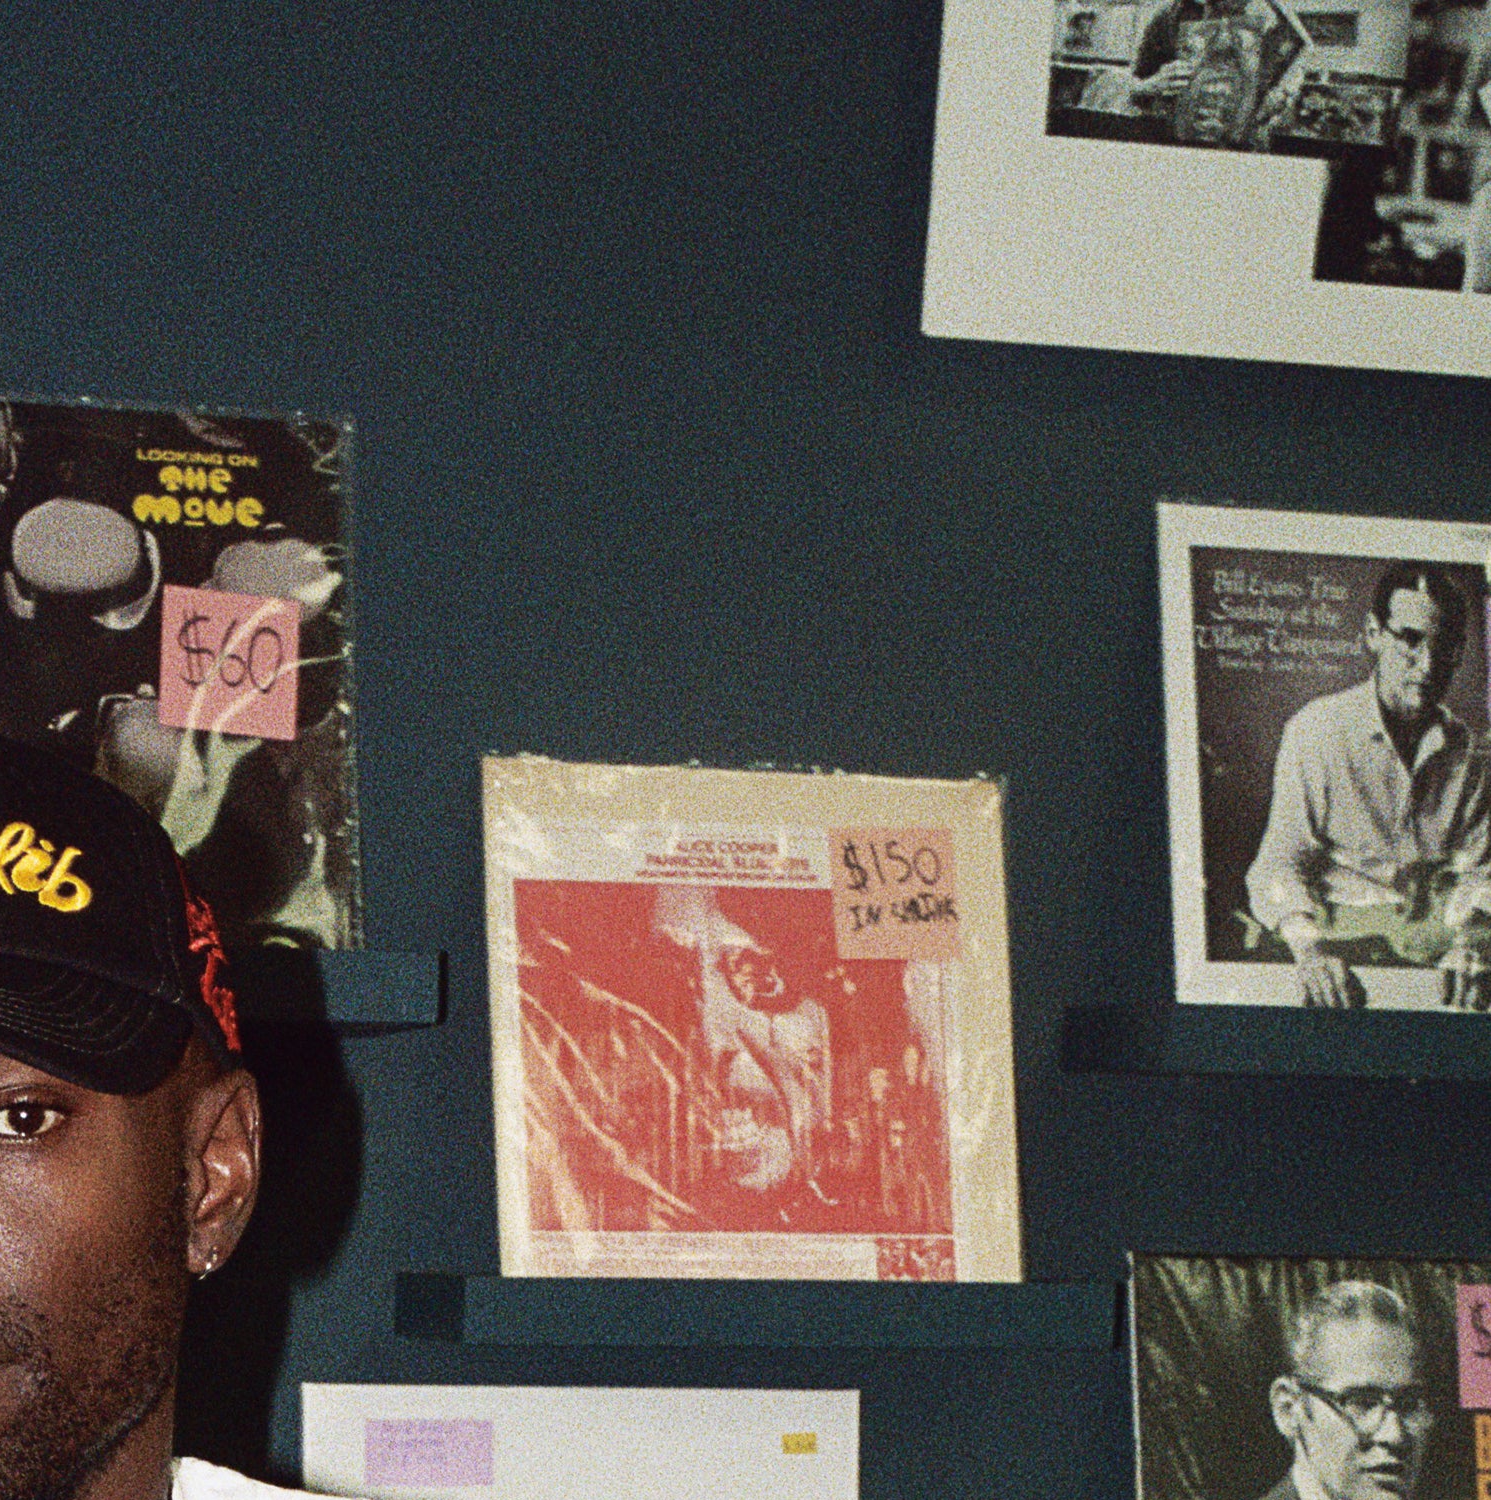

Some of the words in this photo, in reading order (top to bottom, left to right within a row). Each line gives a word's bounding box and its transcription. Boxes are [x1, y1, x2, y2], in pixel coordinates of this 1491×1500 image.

[136, 448, 224, 466] LOOKING
[227, 454, 260, 467] ON
[177, 606, 284, 693] $60
[842, 839, 941, 891] $150
